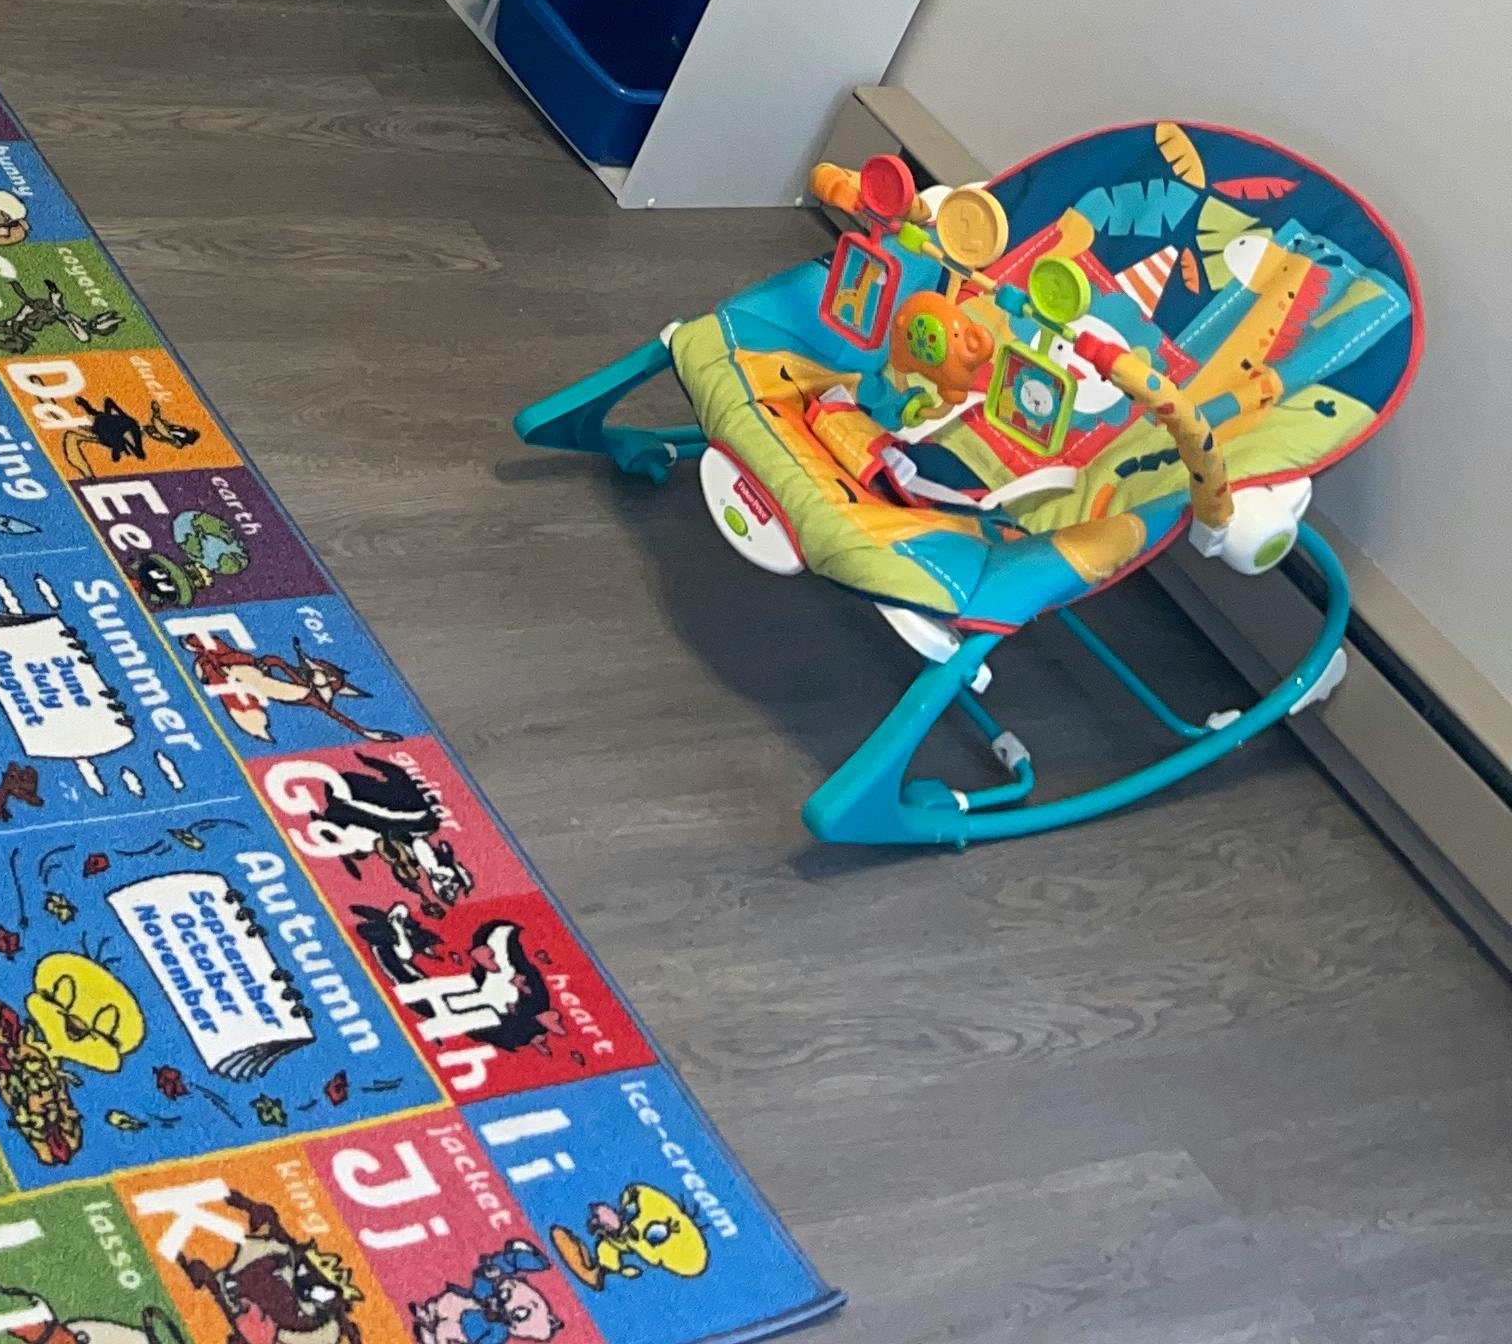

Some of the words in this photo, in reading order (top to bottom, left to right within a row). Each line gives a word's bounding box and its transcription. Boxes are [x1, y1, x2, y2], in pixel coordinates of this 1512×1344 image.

[57, 247, 110, 308] coyote
[129, 355, 174, 403] duck
[211, 476, 262, 535] earth
[73, 578, 202, 752] Summer
[296, 605, 335, 645] fox
[26, 662, 64, 710] July
[52, 655, 92, 708] June
[389, 751, 462, 832] guitar
[133, 903, 220, 1035] November
[171, 912, 243, 1015] October
[188, 890, 283, 1029] September
[235, 851, 381, 1053] Autumn
[546, 974, 615, 1055] heart
[272, 1159, 331, 1235] king
[425, 1122, 512, 1231] jacket
[83, 1200, 141, 1289] lasso
